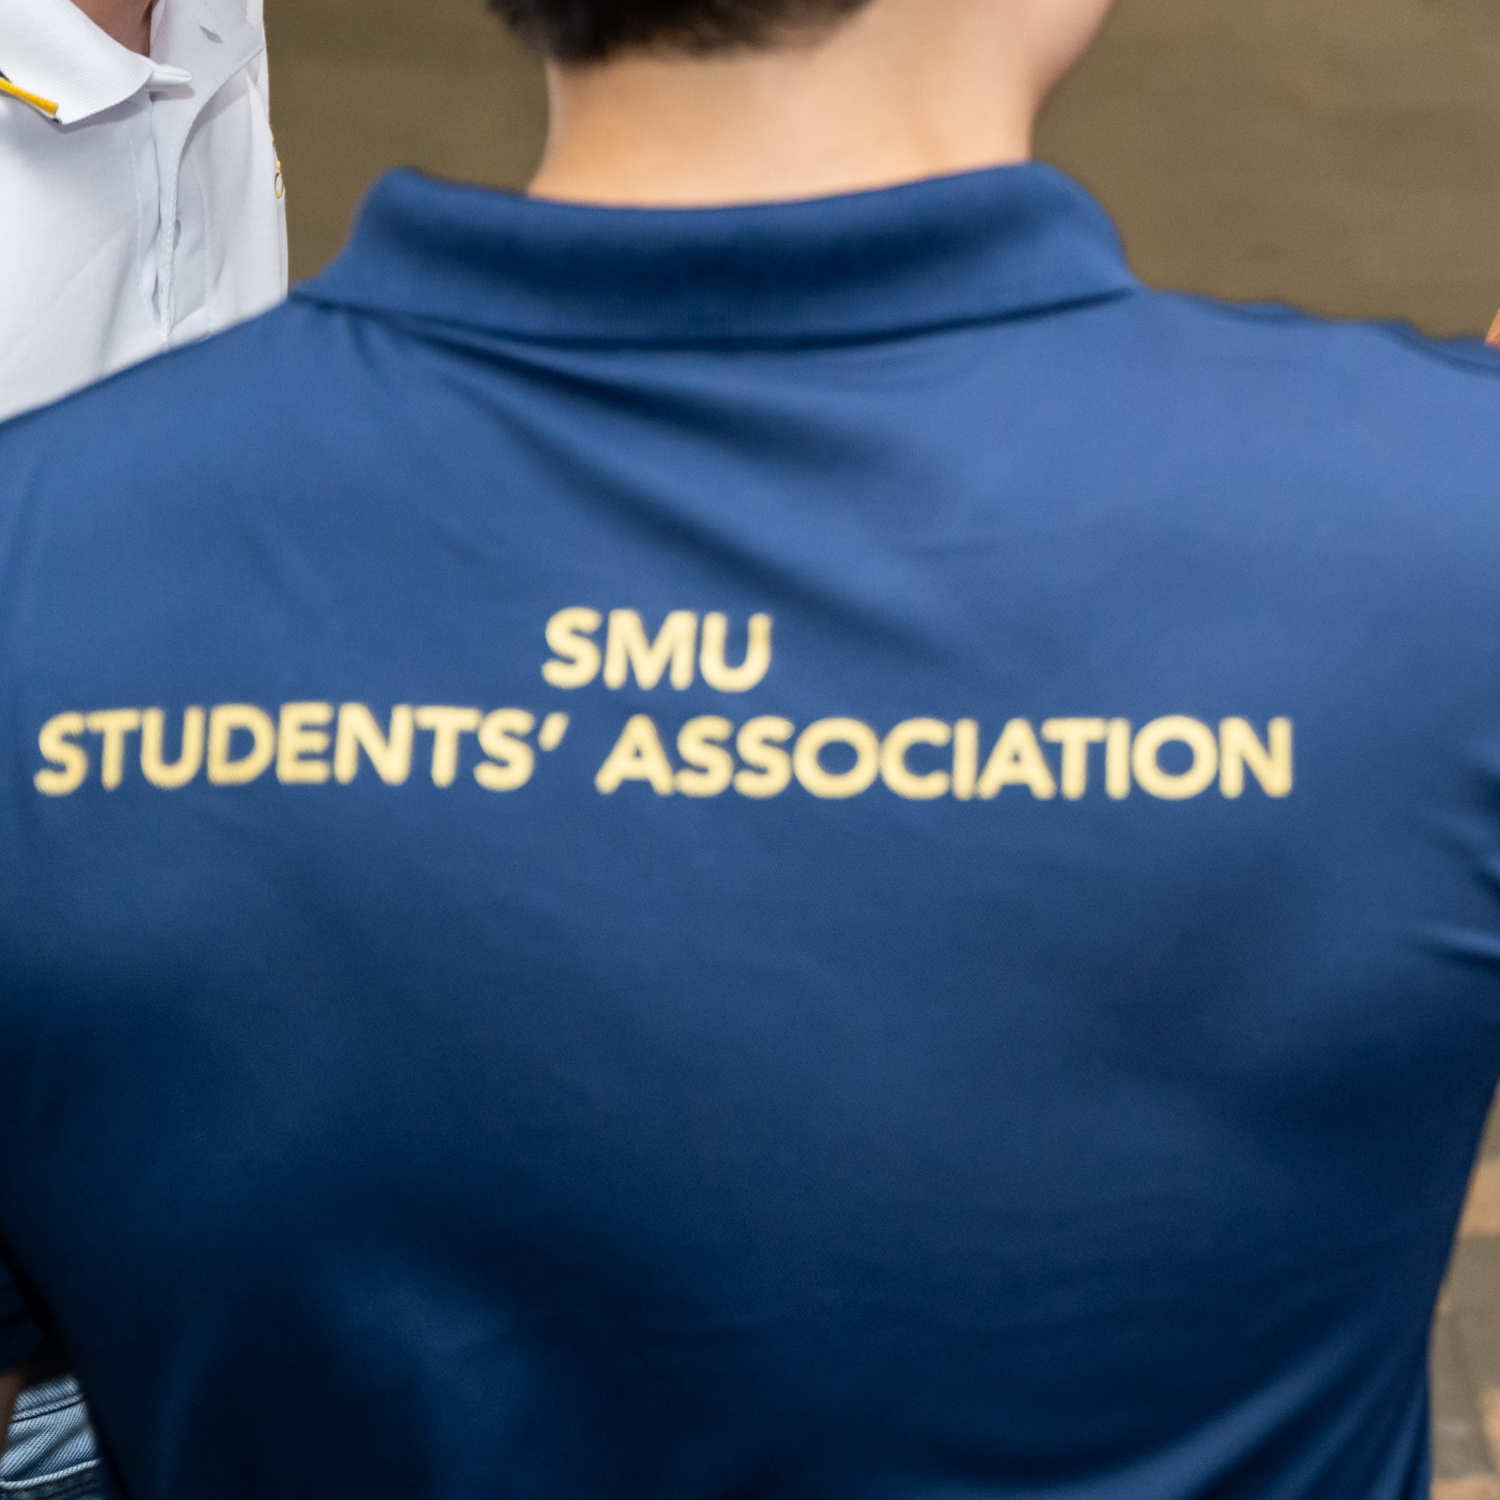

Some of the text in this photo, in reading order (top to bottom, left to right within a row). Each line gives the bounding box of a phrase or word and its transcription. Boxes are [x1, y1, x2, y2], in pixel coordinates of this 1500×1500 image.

[541, 606, 773, 693] SMU
[34, 701, 1294, 801] STUDENTS’ ASSOCIATION
